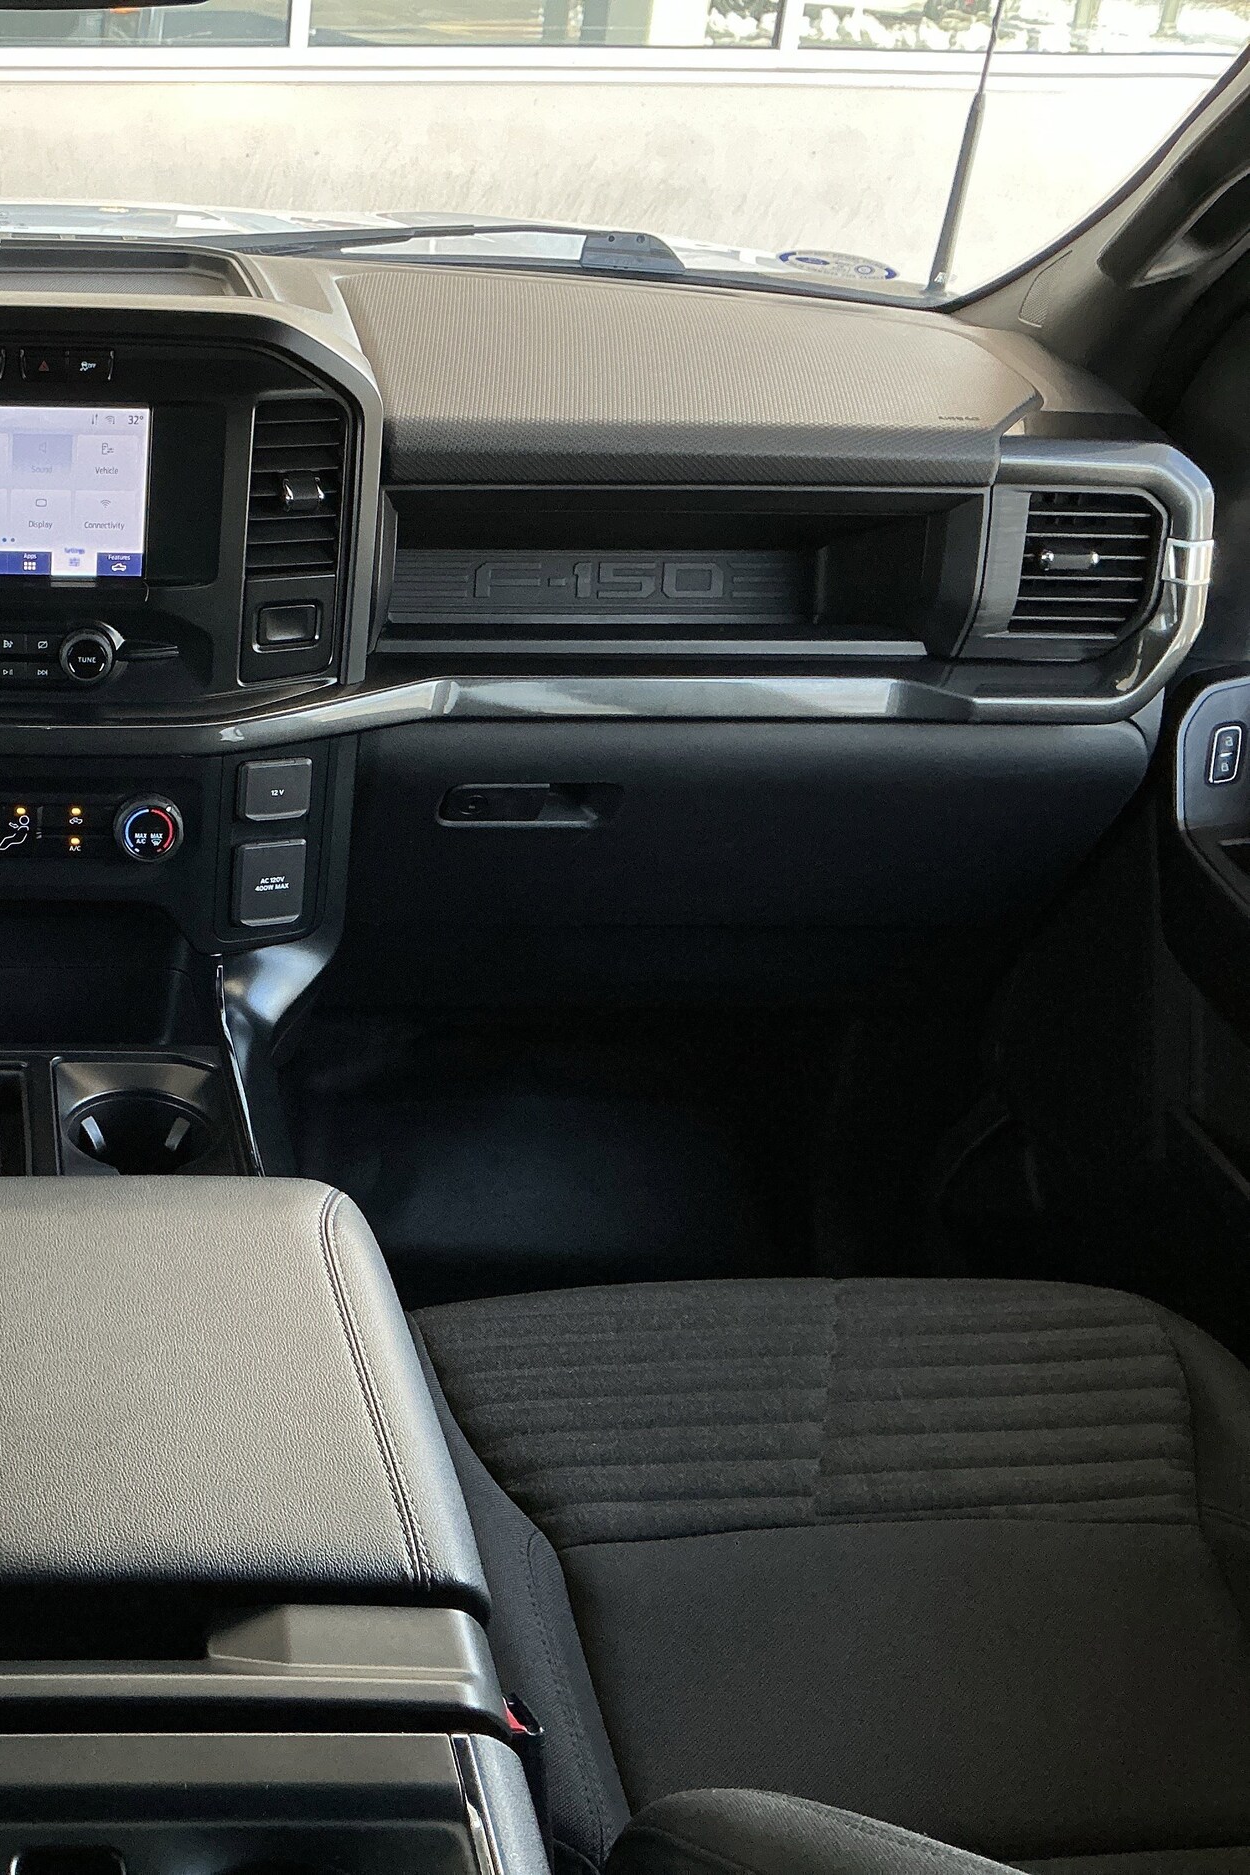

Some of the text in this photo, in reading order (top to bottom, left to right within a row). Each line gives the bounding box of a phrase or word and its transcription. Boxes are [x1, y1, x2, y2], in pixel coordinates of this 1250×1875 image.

[95, 466, 119, 475] Vehicle
[28, 520, 53, 529] Display
[84, 521, 125, 531] Connectivity
[23, 552, 37, 560] Apps
[473, 561, 724, 598] F-150
[274, 882, 290, 890] MAX
